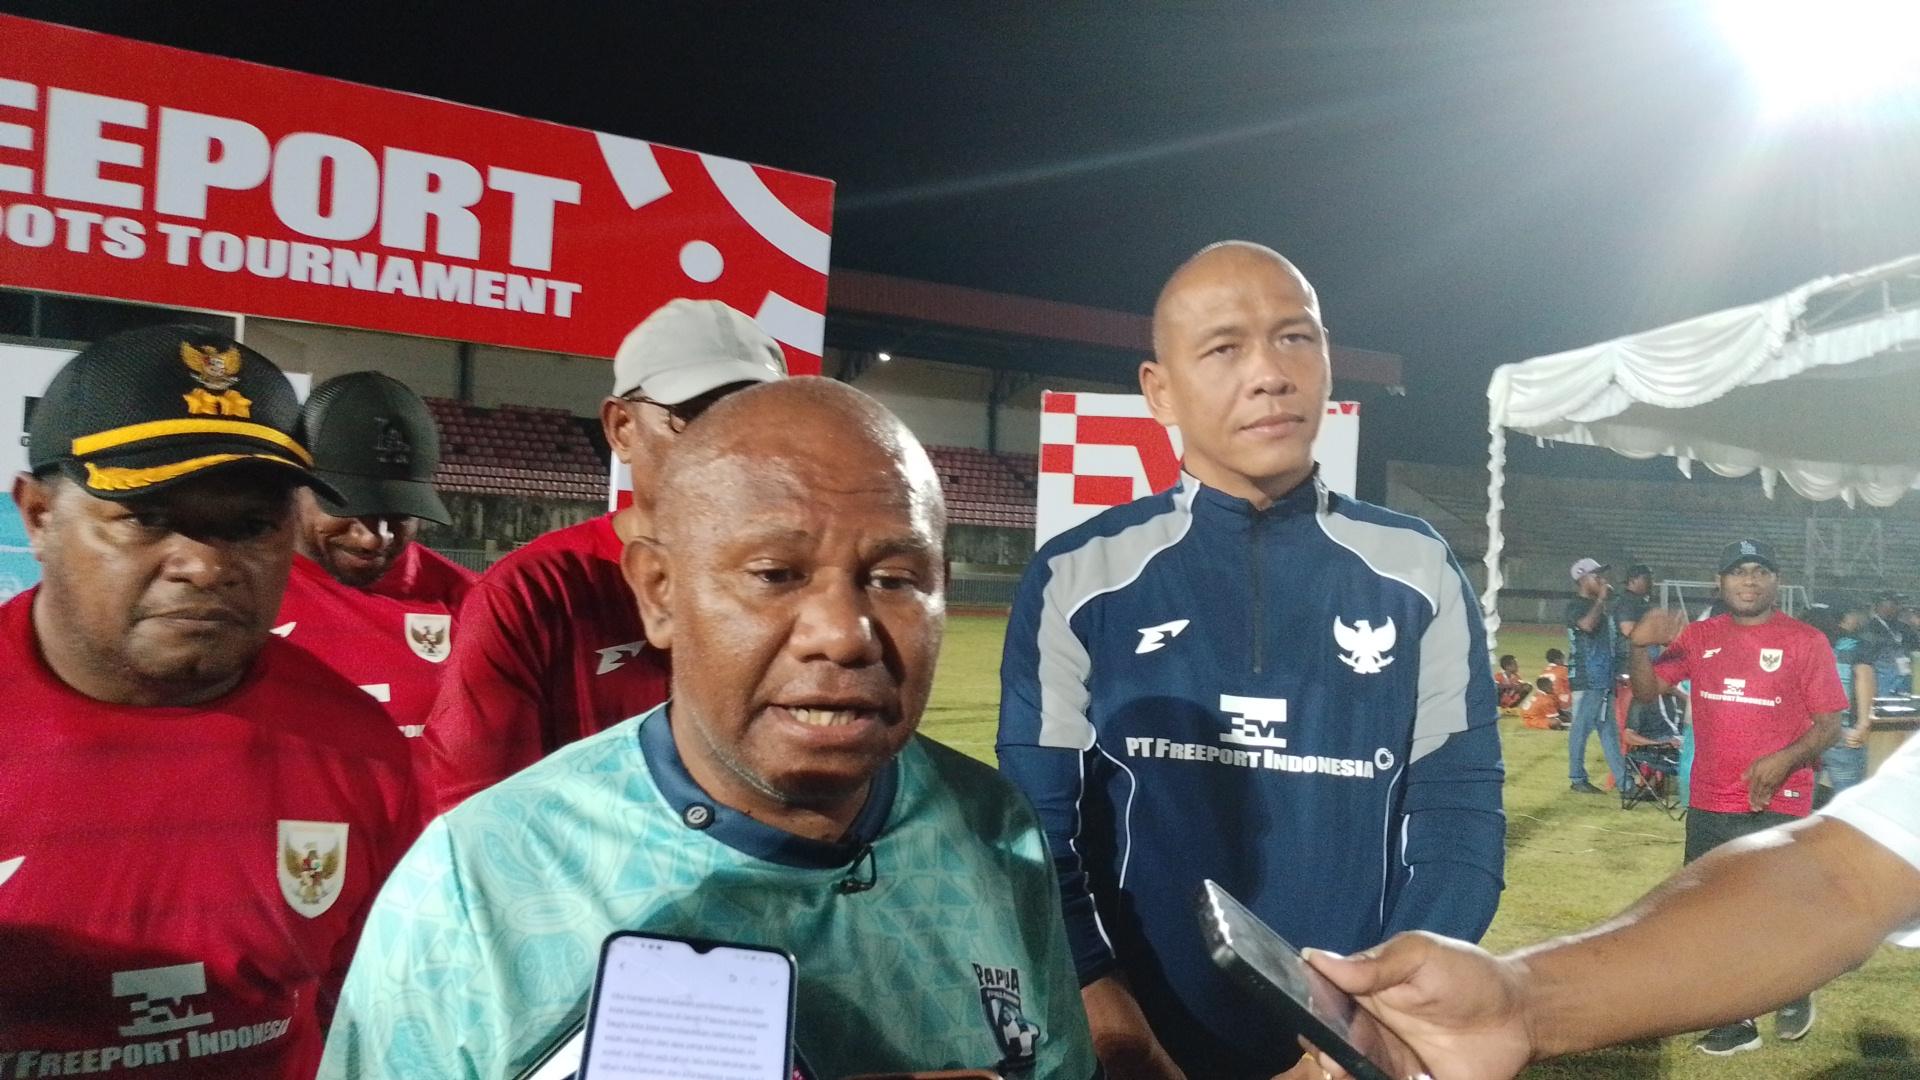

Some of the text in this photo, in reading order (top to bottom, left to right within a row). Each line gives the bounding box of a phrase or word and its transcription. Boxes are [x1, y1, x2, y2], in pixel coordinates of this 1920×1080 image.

[0, 202, 583, 319] OTS TOURNAMENT
[1126, 737, 1375, 779] PT FREEPORT INDONESIA
[972, 962, 1020, 995] PAPUA
[15, 1038, 182, 1079] FREEPORT
